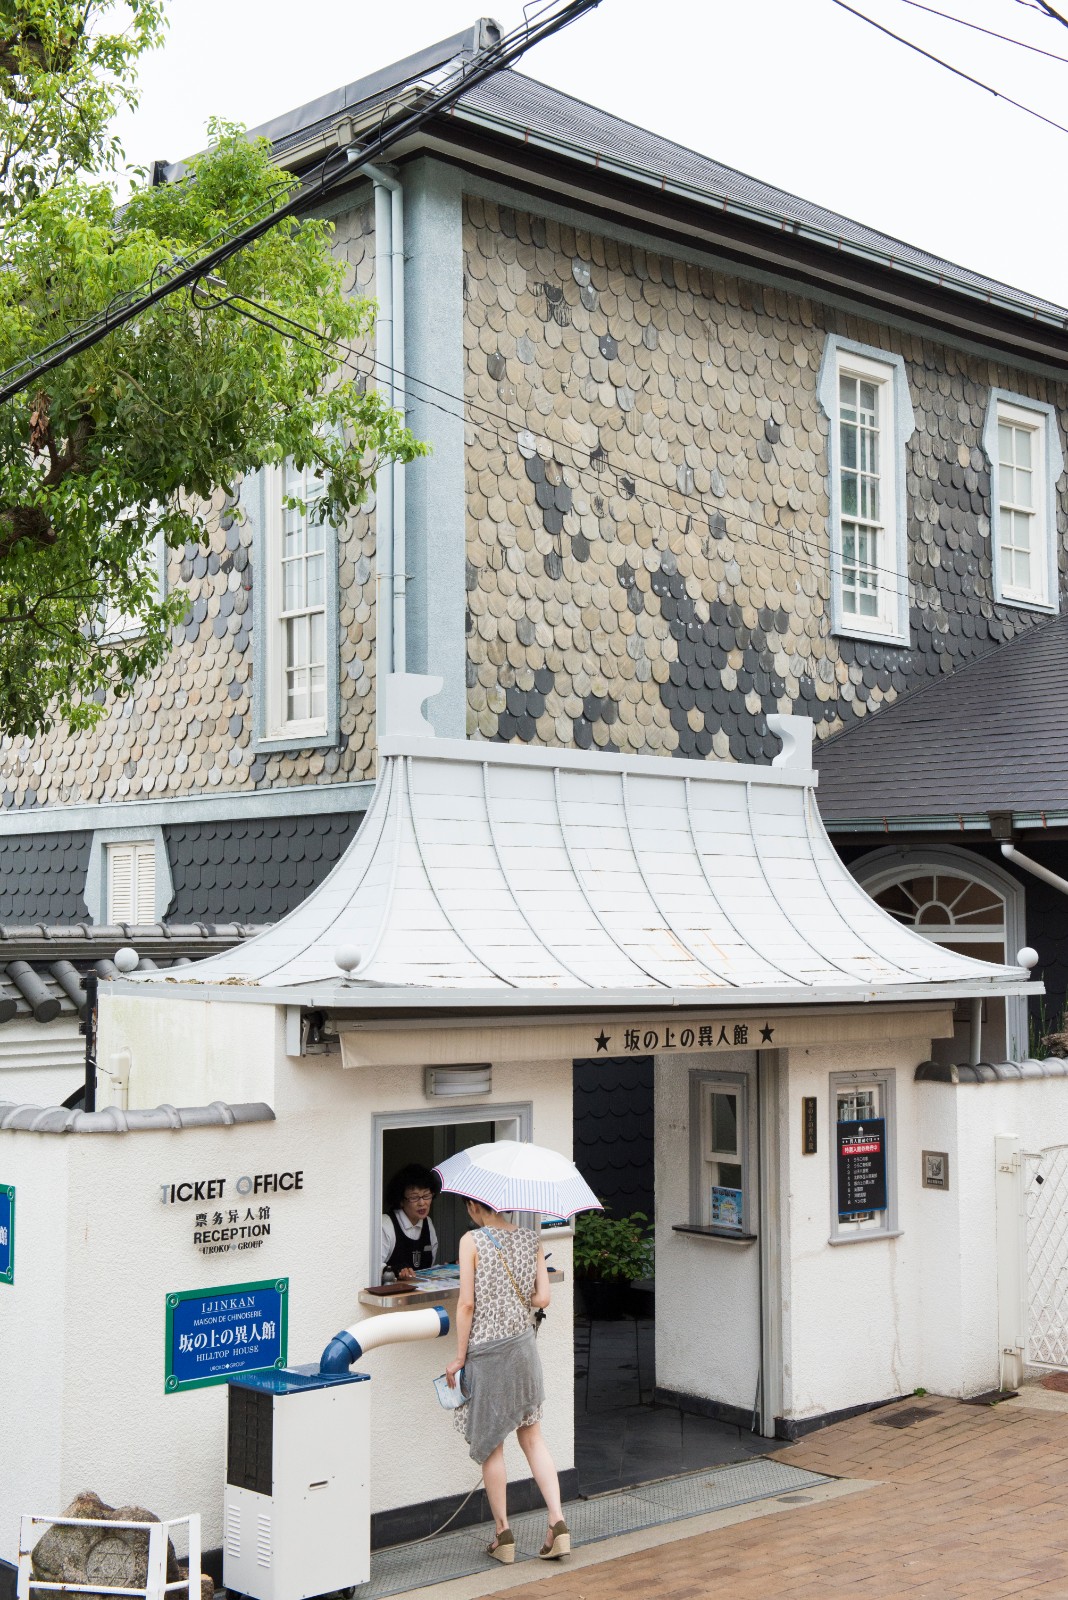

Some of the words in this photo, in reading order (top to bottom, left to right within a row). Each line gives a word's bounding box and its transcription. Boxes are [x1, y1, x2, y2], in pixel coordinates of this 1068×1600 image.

[624, 1024, 749, 1051] 坂の上の異人館
[160, 1179, 226, 1204] TICKET
[236, 1171, 303, 1195] OFFICE
[195, 1206, 271, 1228] 票务异人馆
[193, 1224, 271, 1244] RECEPTION
[201, 1296, 256, 1313] IJINKAN
[193, 1315, 218, 1327] MAISON
[218, 1315, 227, 1323] DE
[227, 1310, 263, 1322] CHINOISERIE
[178, 1320, 276, 1353] 坂の上の異人館
[196, 1350, 230, 1362] HILLTOP
[233, 1345, 259, 1356] HOUSE
